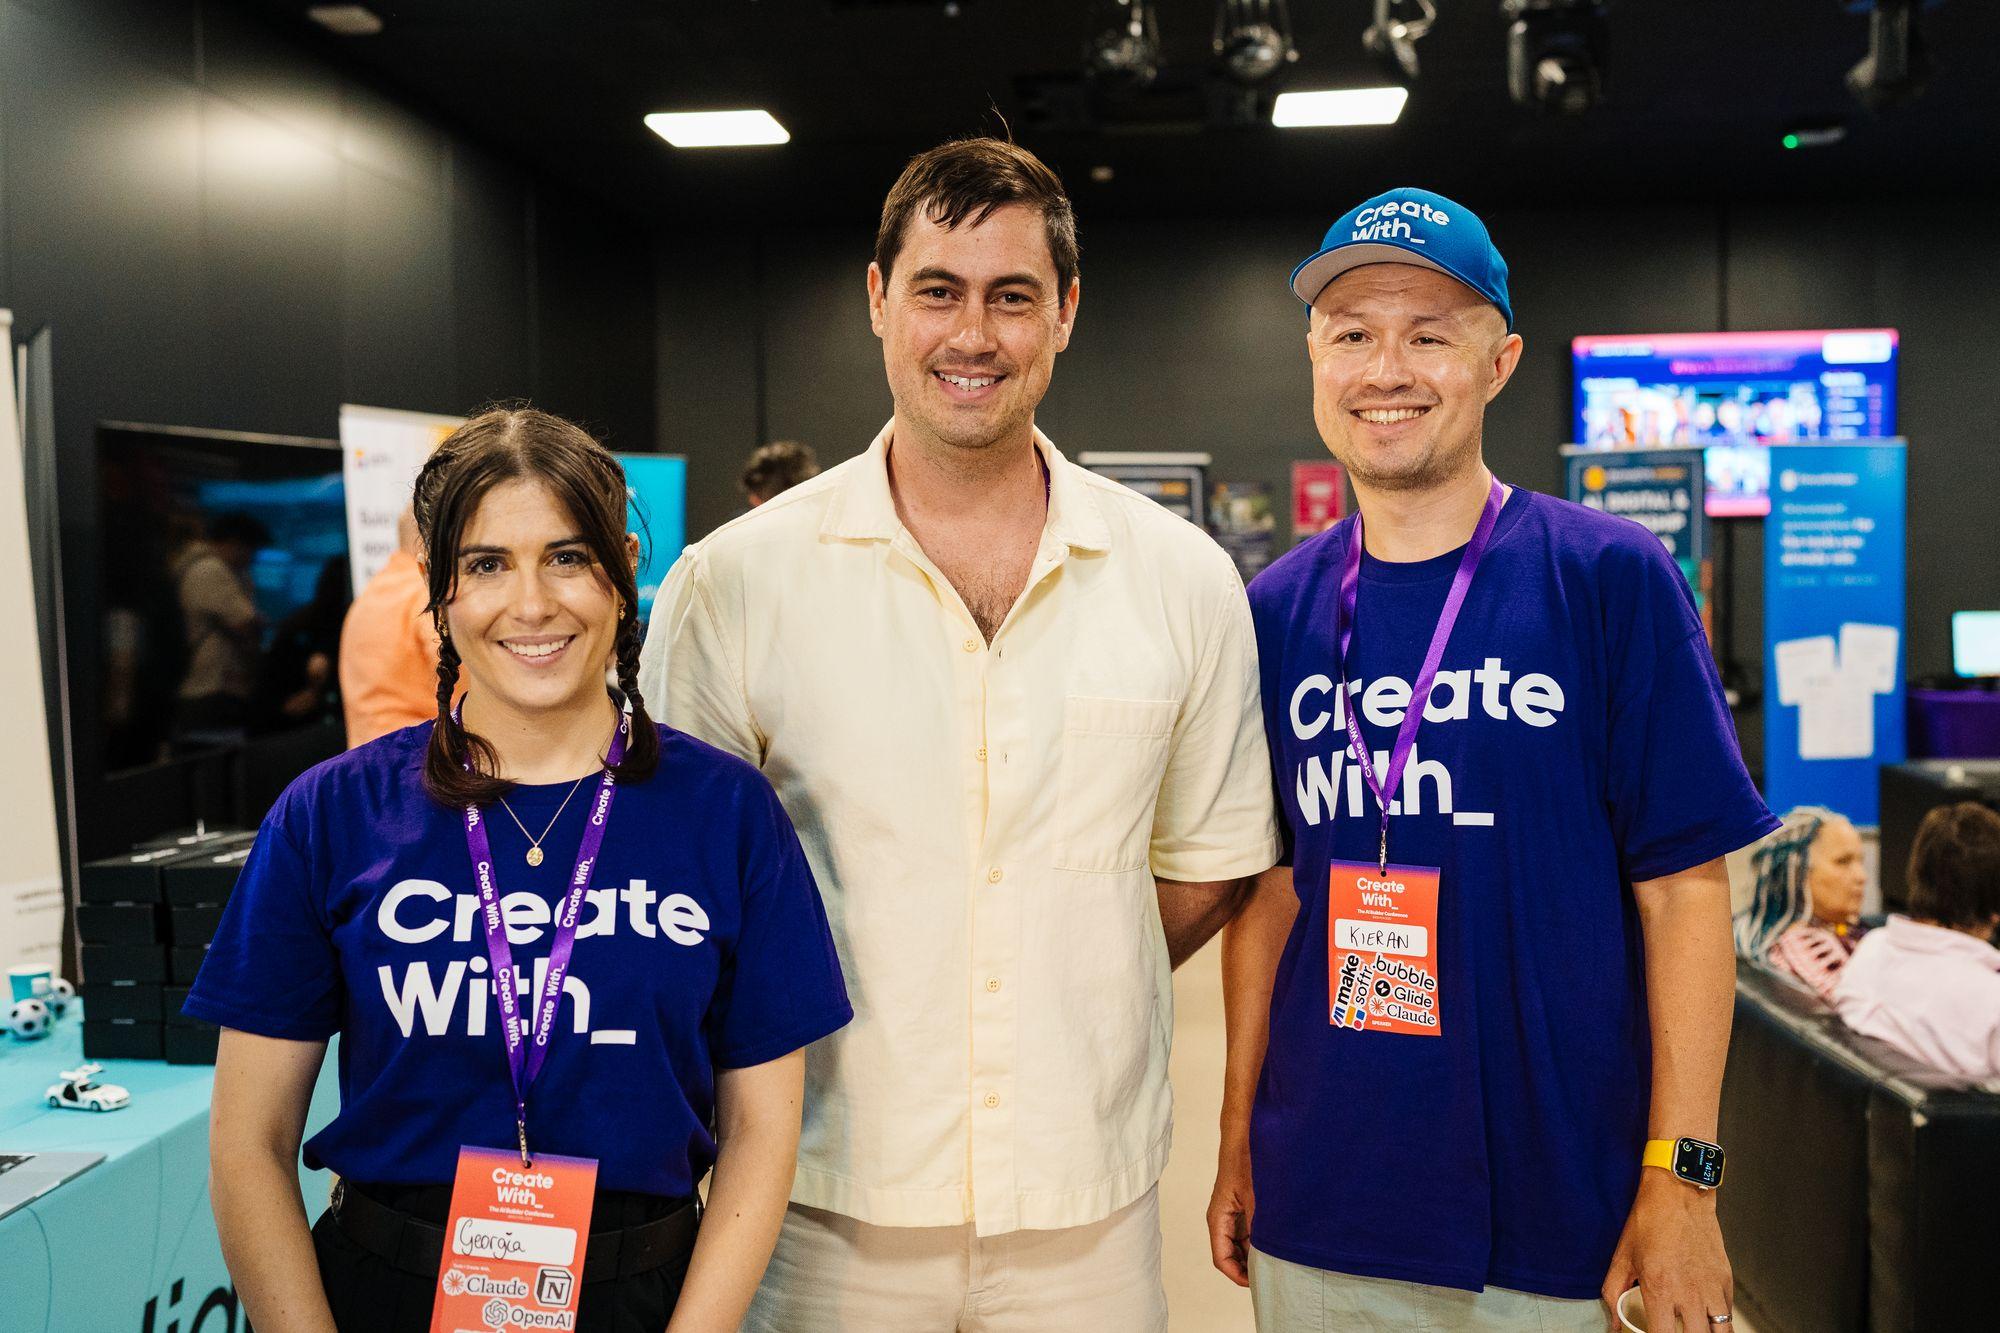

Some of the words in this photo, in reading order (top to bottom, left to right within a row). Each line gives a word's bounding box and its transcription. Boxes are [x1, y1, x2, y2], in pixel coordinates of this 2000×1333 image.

[1355, 202, 1450, 226] Create
[1289, 658, 1565, 740] Create
[1347, 711, 1359, 742] With_
[1356, 742, 1372, 778] Create
[592, 789, 611, 826] Create
[477, 861, 493, 901] Create
[485, 902, 501, 935] With_
[563, 888, 583, 929] Create
[574, 856, 594, 886] With_
[1356, 877, 1405, 894] Create
[377, 879, 711, 946] Create
[1361, 892, 1399, 910] With_
[1350, 926, 1409, 949] KIERAN
[1337, 955, 1359, 1006] make
[1355, 965, 1373, 1005] softr
[499, 968, 513, 1014] Create
[506, 1016, 520, 1053] With_
[536, 1000, 555, 1046] Create
[546, 963, 565, 997] With_
[1394, 986, 1433, 1008] Glide
[1387, 1004, 1436, 1026] Claude
[491, 1168, 554, 1189] Create
[1703, 1162, 1713, 1181] 14:21
[497, 1186, 544, 1209] With_
[459, 1219, 526, 1260] Georgia
[466, 1276, 528, 1296] Claude
[546, 1281, 565, 1299] N
[511, 1308, 572, 1328] OpenAI
